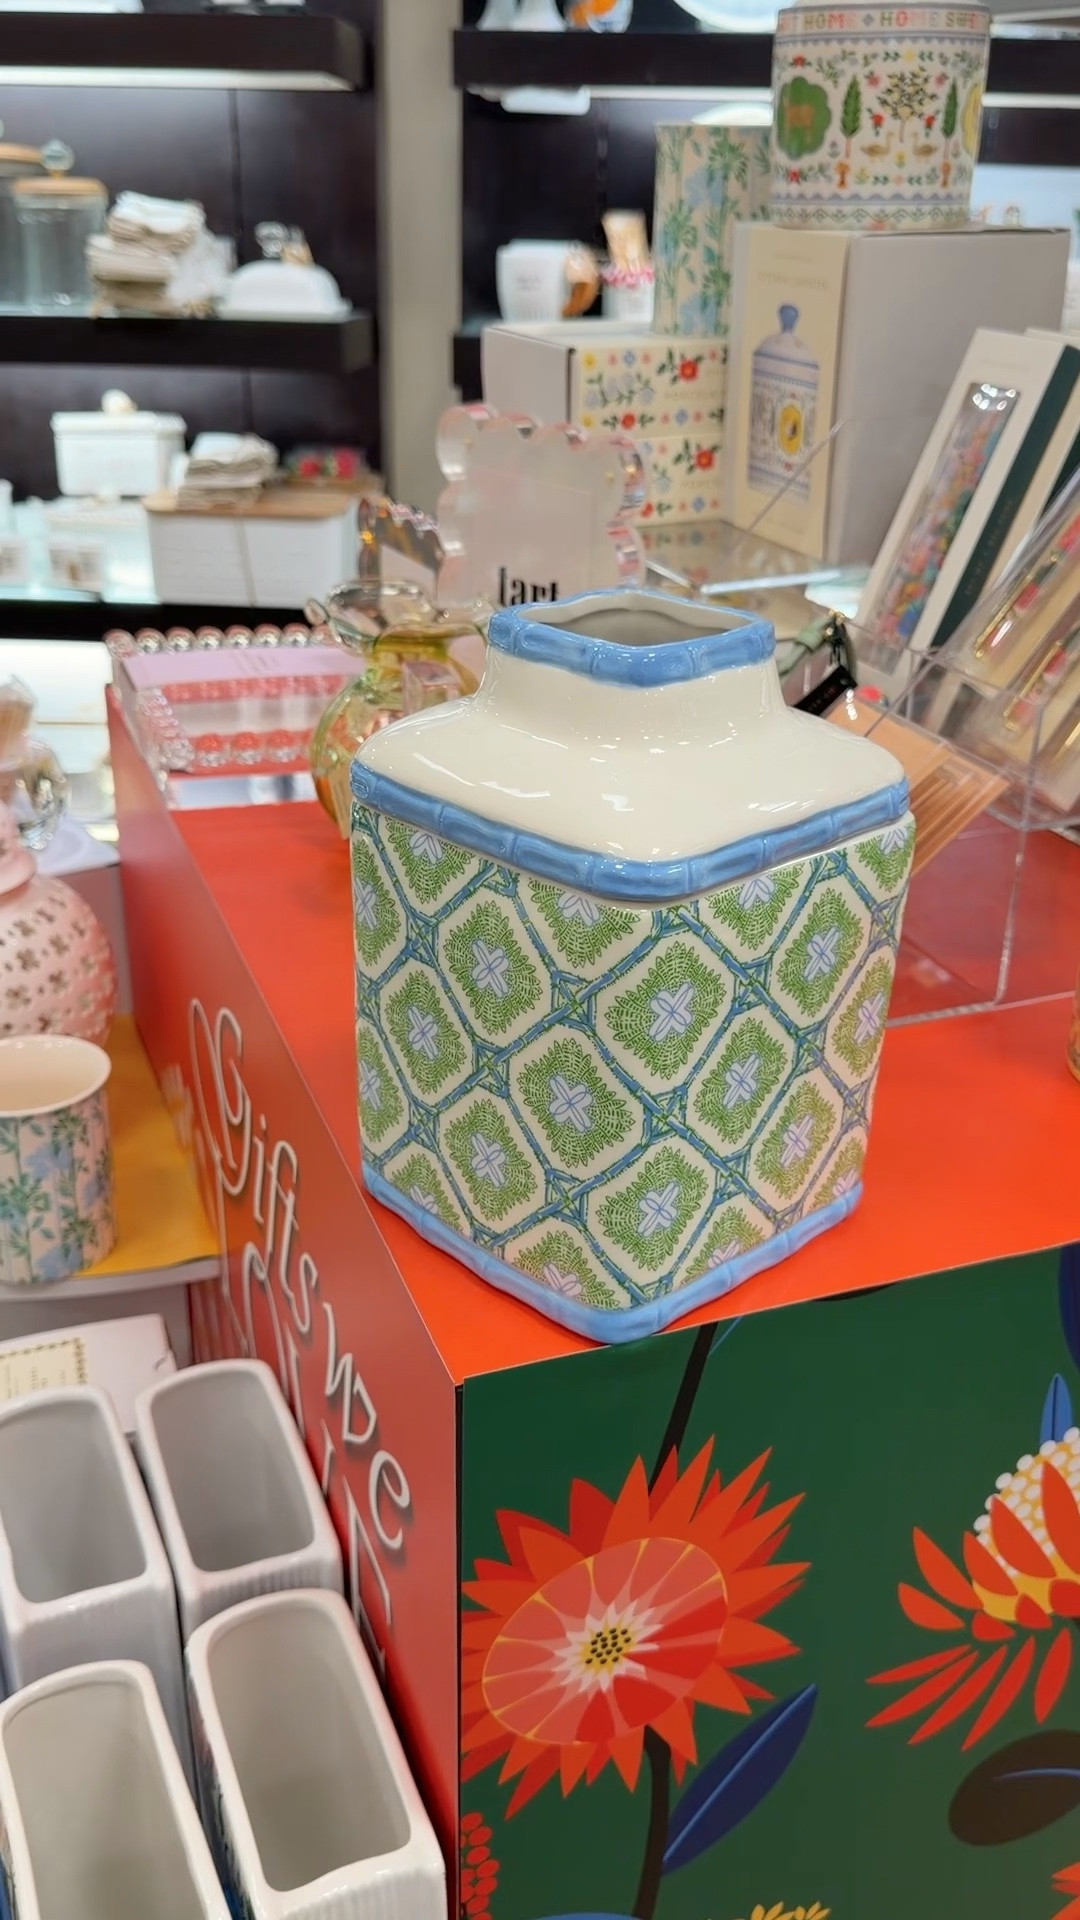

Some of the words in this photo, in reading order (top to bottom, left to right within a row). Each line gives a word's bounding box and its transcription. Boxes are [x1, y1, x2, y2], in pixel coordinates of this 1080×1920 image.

[803, 12, 857, 30] HOME
[880, 11, 940, 28] HOME
[188, 998, 318, 1334] Gifts
[323, 1302, 411, 1551] we
